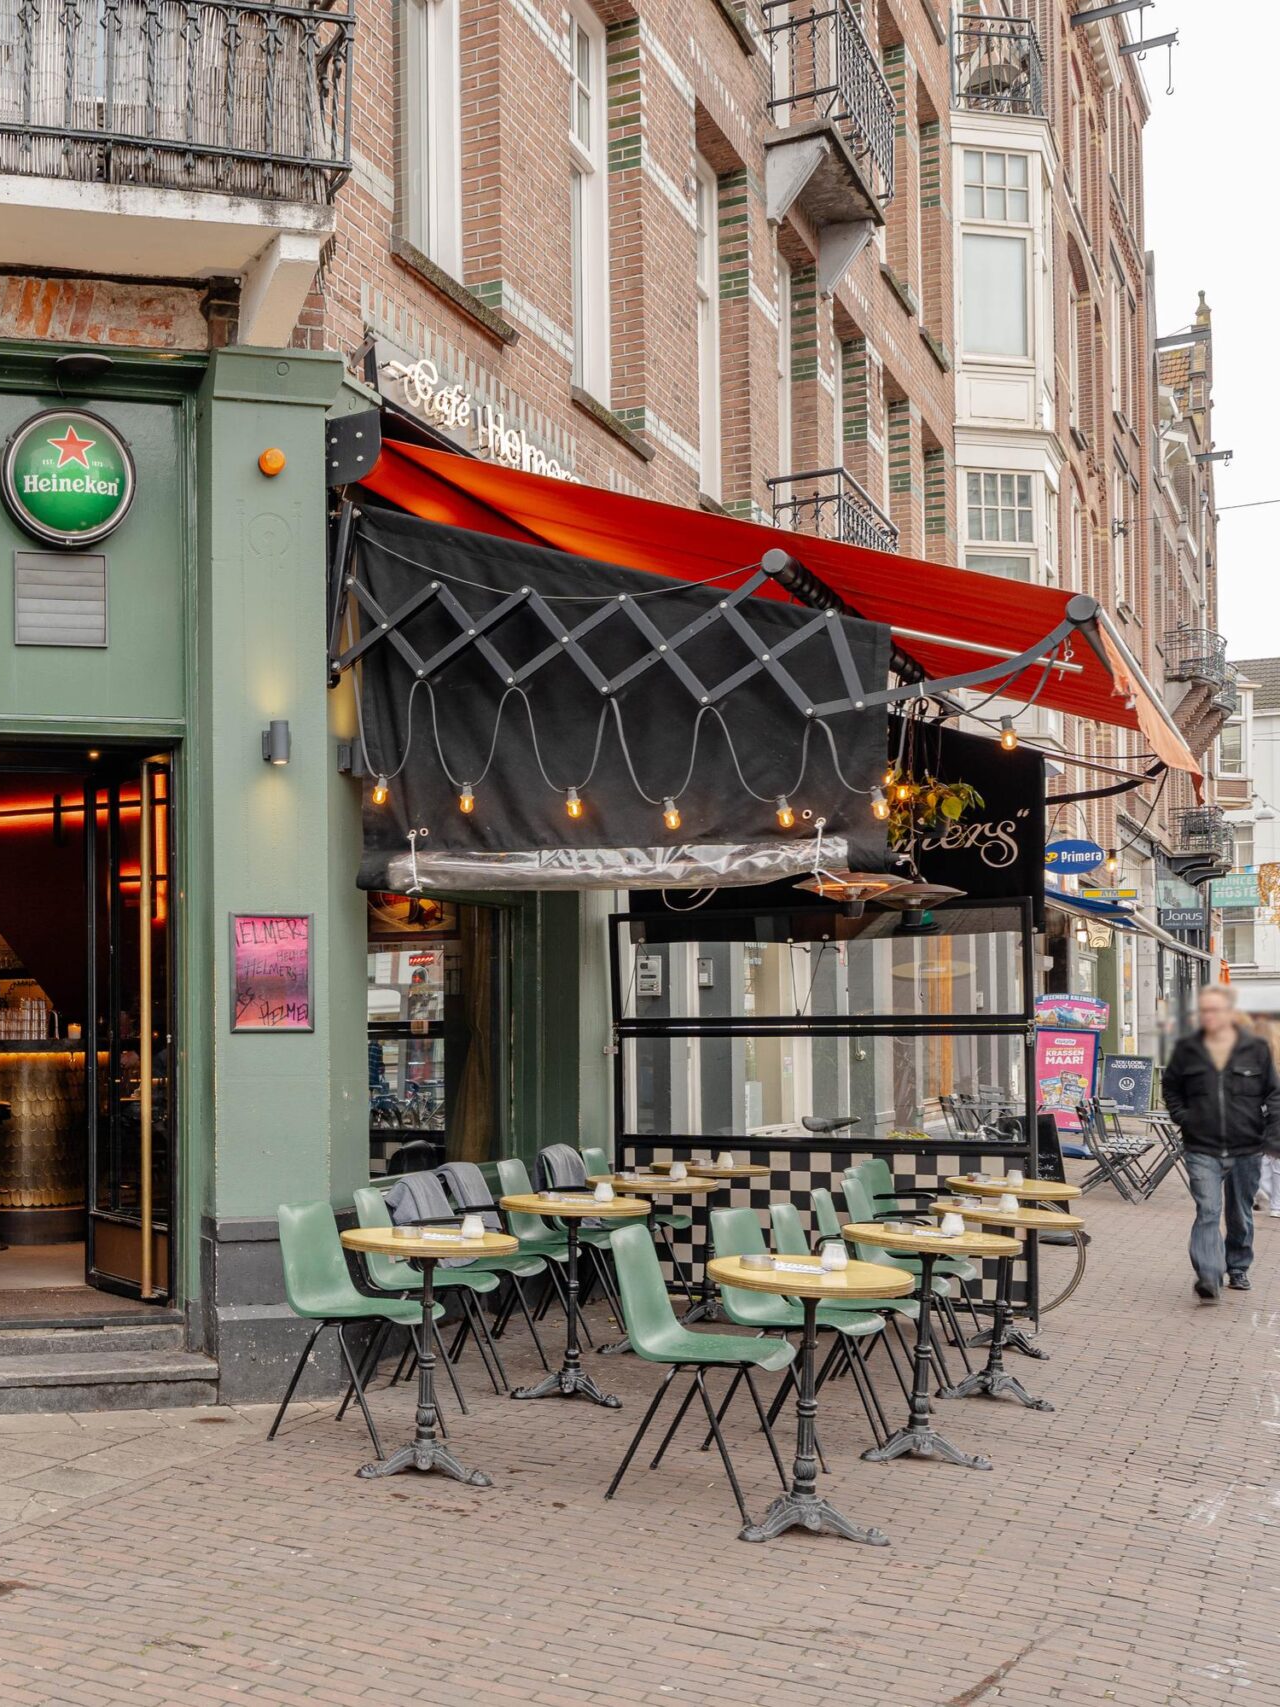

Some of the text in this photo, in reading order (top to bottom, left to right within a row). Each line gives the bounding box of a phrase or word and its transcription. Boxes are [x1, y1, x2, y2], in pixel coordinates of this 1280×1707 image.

[23, 473, 118, 497] Heineken
[1060, 851, 1102, 863] Primera
[1215, 886, 1258, 898] HOSTE
[1165, 910, 1203, 921] Janus
[1045, 1056, 1084, 1065] MAAR!
